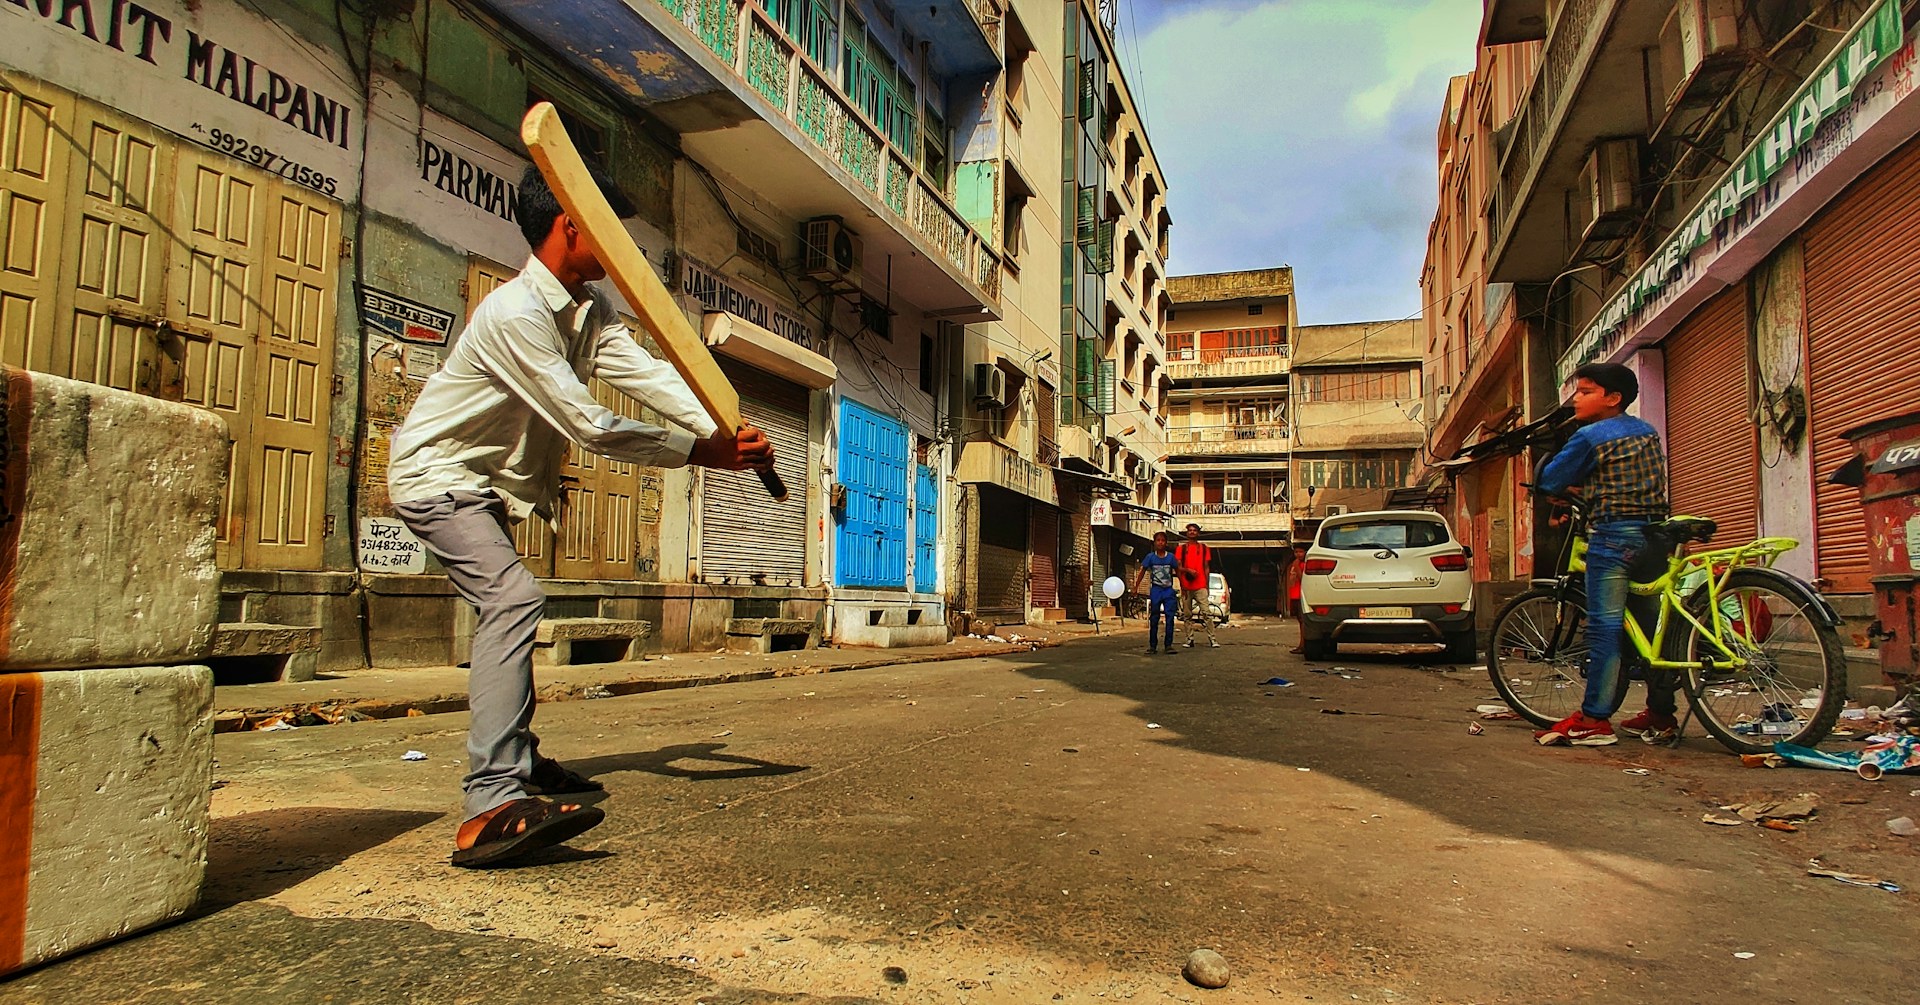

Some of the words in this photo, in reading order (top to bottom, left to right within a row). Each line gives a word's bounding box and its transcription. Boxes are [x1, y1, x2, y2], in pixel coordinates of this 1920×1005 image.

[184, 29, 351, 151] MALPANI
[209, 128, 338, 195] 9929771595
[1642, 164, 1758, 291] MEDICAL
[1765, 38, 1877, 171] HALL
[364, 294, 444, 329] BELTEK
[684, 266, 716, 308] JAIN
[720, 282, 771, 331] MEDICAL
[773, 311, 812, 350] STORES
[360, 539, 421, 552] 9314823602
[390, 552, 413, 566] कार्य
